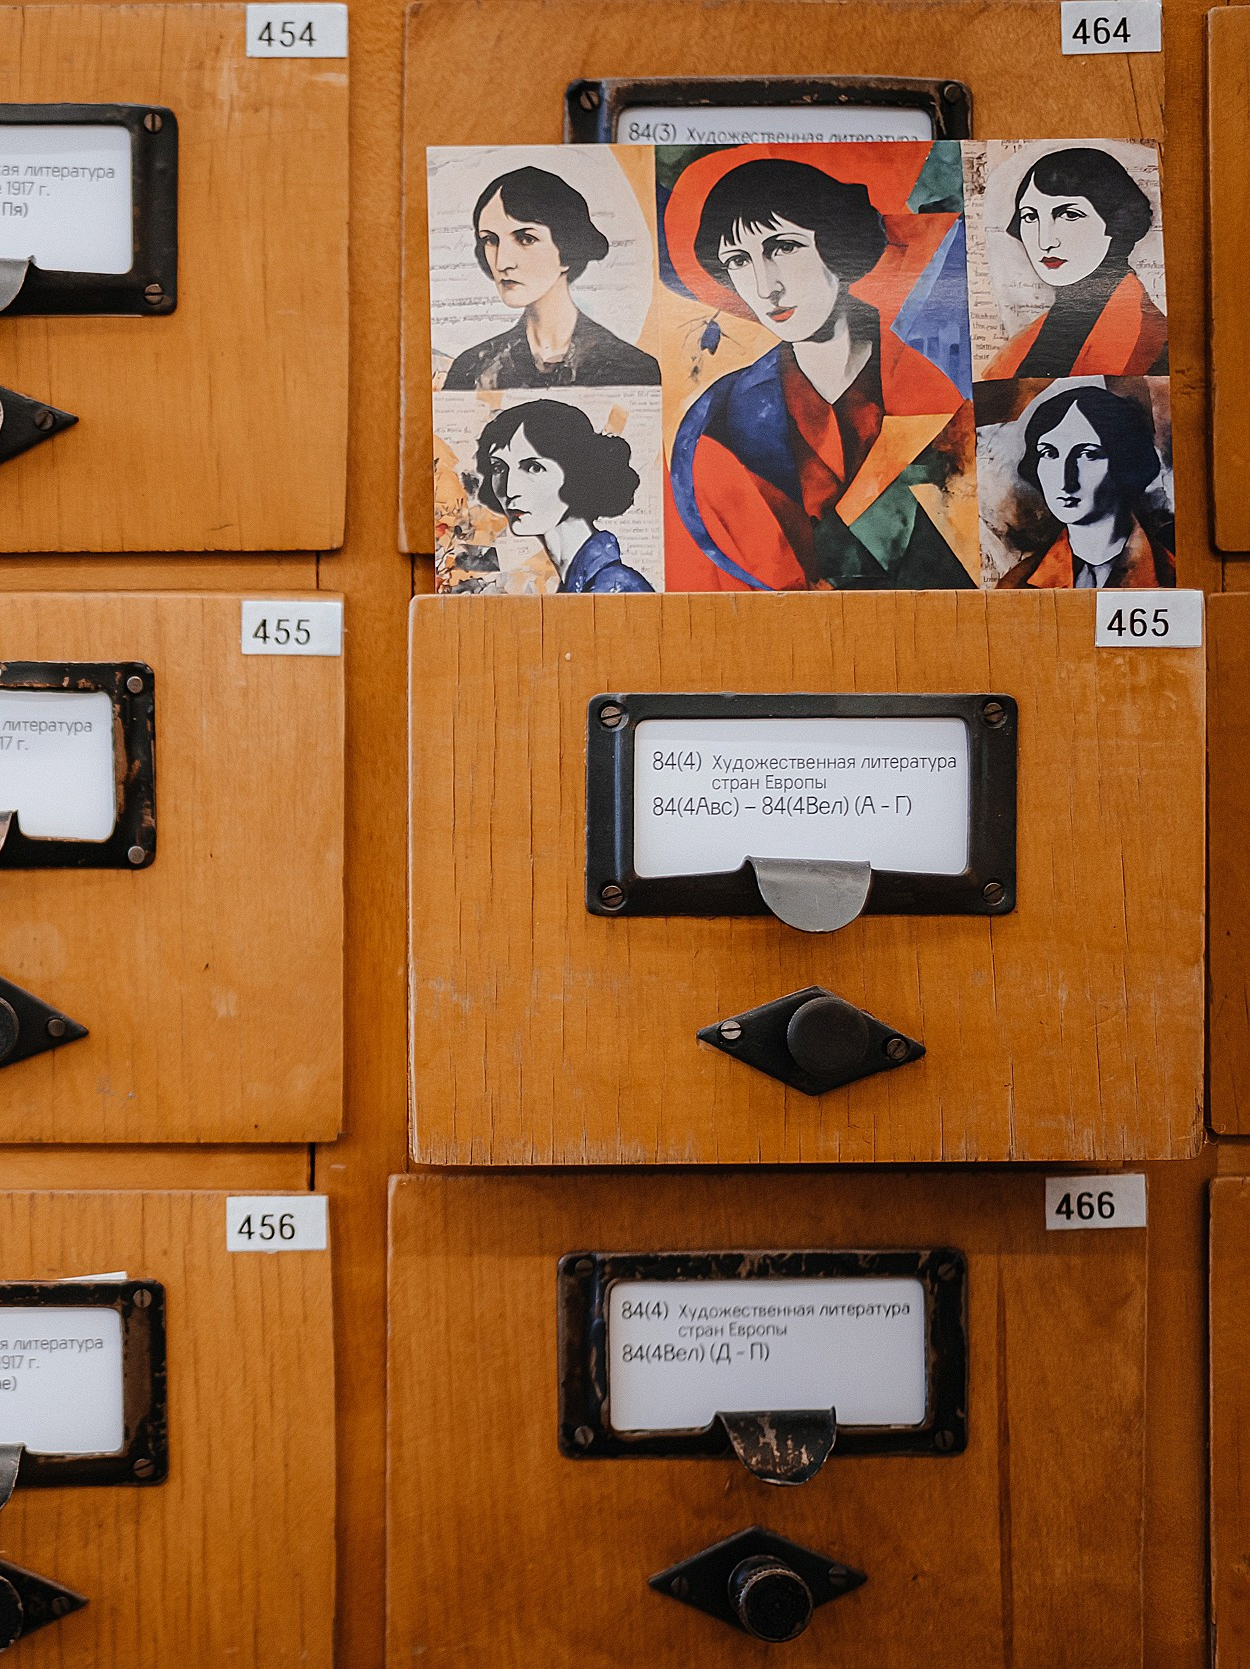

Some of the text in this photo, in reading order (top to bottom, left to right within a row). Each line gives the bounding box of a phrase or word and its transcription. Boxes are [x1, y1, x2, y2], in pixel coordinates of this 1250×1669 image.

[258, 22, 316, 47] 454
[1072, 17, 1131, 44] 464
[629, 123, 677, 143] 84(3)
[24, 164, 114, 182] литература
[7, 181, 35, 195] 1917
[39, 185, 50, 196] г.
[3, 202, 28, 218] Пя)
[253, 619, 310, 645] 455
[1107, 609, 1169, 636] 465
[2, 719, 92, 736] литература
[17, 740, 28, 750] г.
[653, 751, 957, 773] 84(4) Художественная литература
[712, 775, 826, 793] стран Европы
[653, 797, 739, 817] 84(4Авс)
[762, 796, 848, 816] 84(4Вел)
[855, 796, 875, 816] (А
[896, 796, 911, 816] Г)
[1055, 1191, 1114, 1220] 466
[238, 1214, 295, 1240] 456
[622, 1301, 910, 1324] 84(4) Художественная литература
[678, 1322, 787, 1340] стран Европы
[14, 1337, 103, 1354] литература
[622, 1344, 705, 1362] 84(4Вел)
[710, 1343, 731, 1364] (Д
[751, 1342, 769, 1362] П)
[29, 1358, 40, 1368] г.
